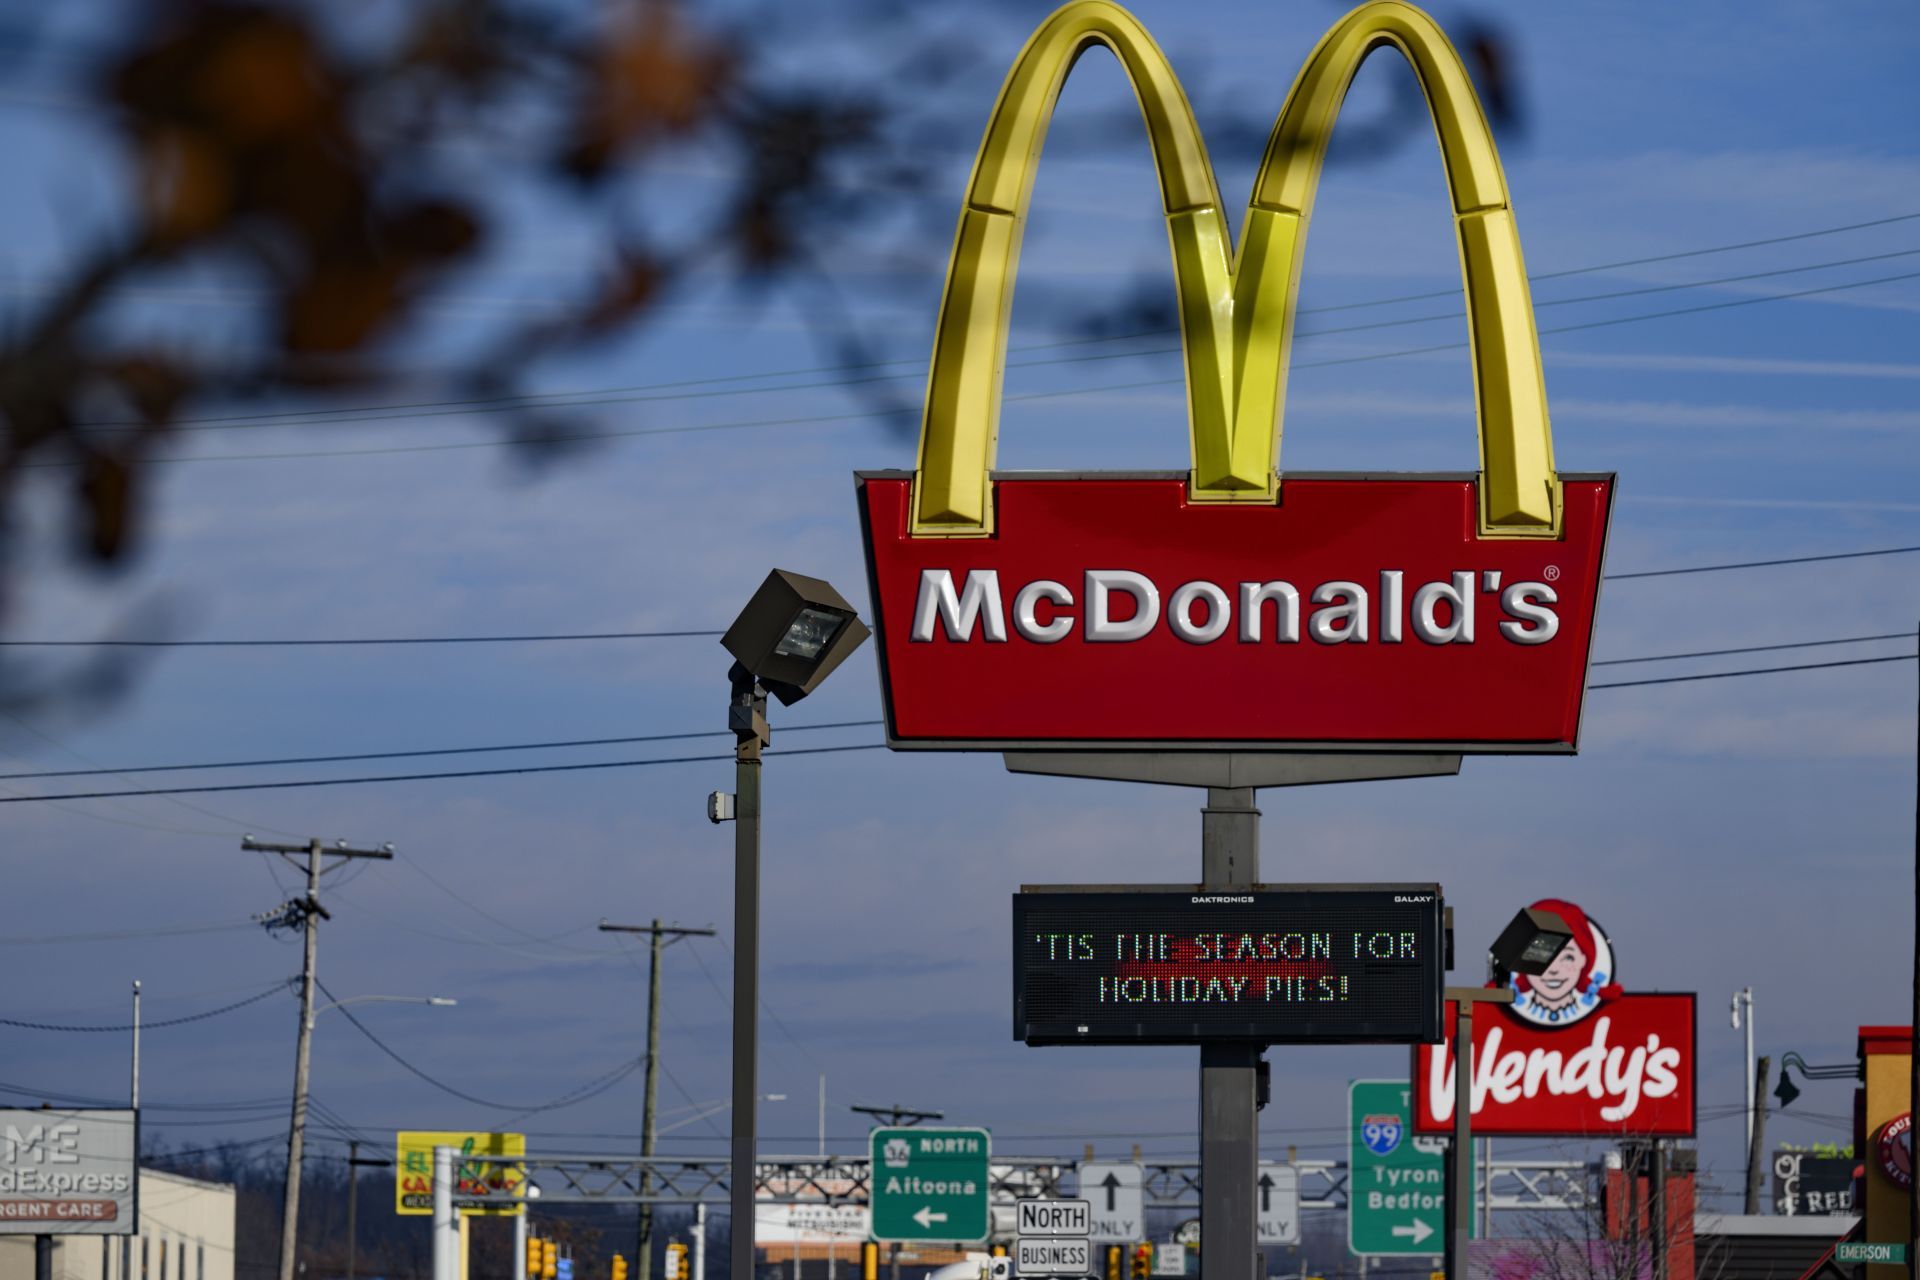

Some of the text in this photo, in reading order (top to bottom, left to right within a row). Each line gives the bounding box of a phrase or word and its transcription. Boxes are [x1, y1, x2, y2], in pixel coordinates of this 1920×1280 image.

[908, 567, 1558, 646] McDonald's
[1191, 896, 1255, 904] DAKTRONICS
[1394, 895, 1431, 903] GALAXY
[1036, 932, 1416, 960] 'TIS THE SEASON FOR
[1100, 975, 1348, 1002] HOLIDAY PIES!
[1429, 1016, 1681, 1122] Wendy's
[1365, 1124, 1398, 1147] 99
[886, 1138, 979, 1162] 36 NORTH
[885, 1176, 977, 1195] Altoona
[1373, 1166, 1445, 1187] Tyron
[56, 1202, 103, 1217] CARE
[1368, 1191, 1445, 1210] Bedfor
[1023, 1205, 1085, 1228] NORTH
[1257, 1221, 1289, 1236] NLY
[1021, 1247, 1086, 1265] BUSINESS
[1839, 1245, 1891, 1260] EMERSON
